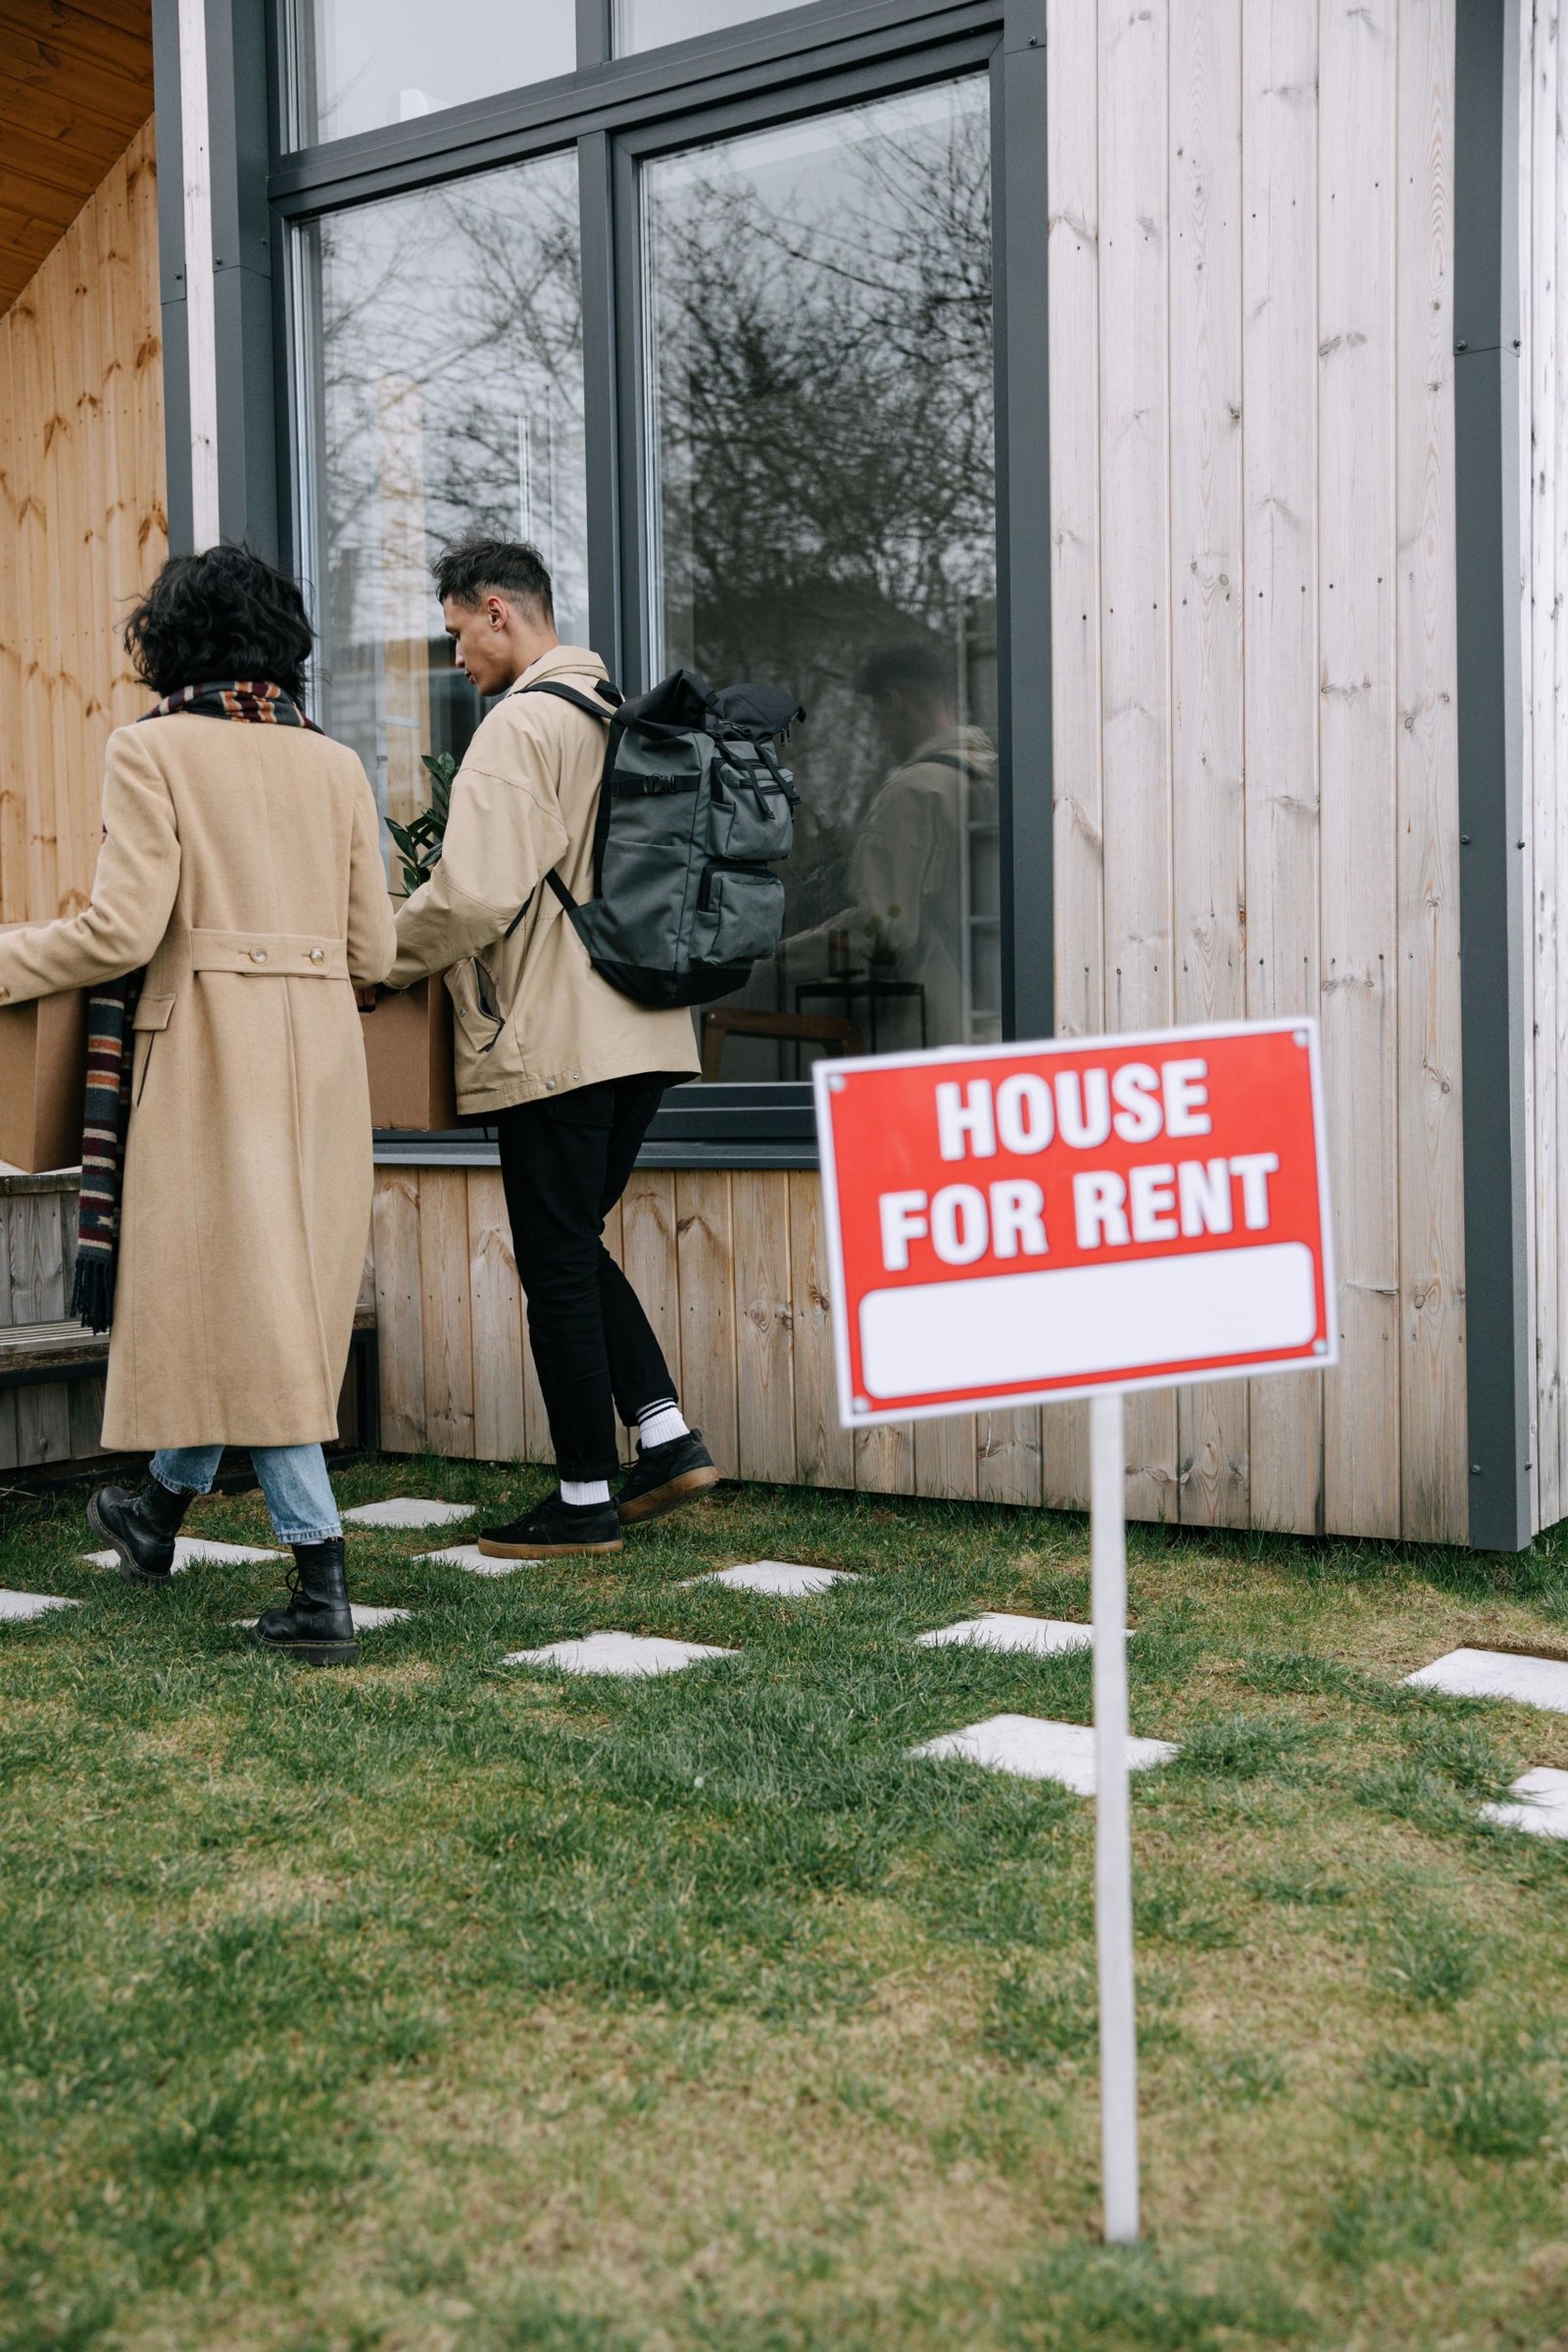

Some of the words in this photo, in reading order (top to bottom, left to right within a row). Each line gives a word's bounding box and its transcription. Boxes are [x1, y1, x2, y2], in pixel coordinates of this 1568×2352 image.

[935, 1057, 1212, 1161] HOUSE
[879, 1179, 1049, 1271] FOR
[1073, 1152, 1279, 1250] RENT
